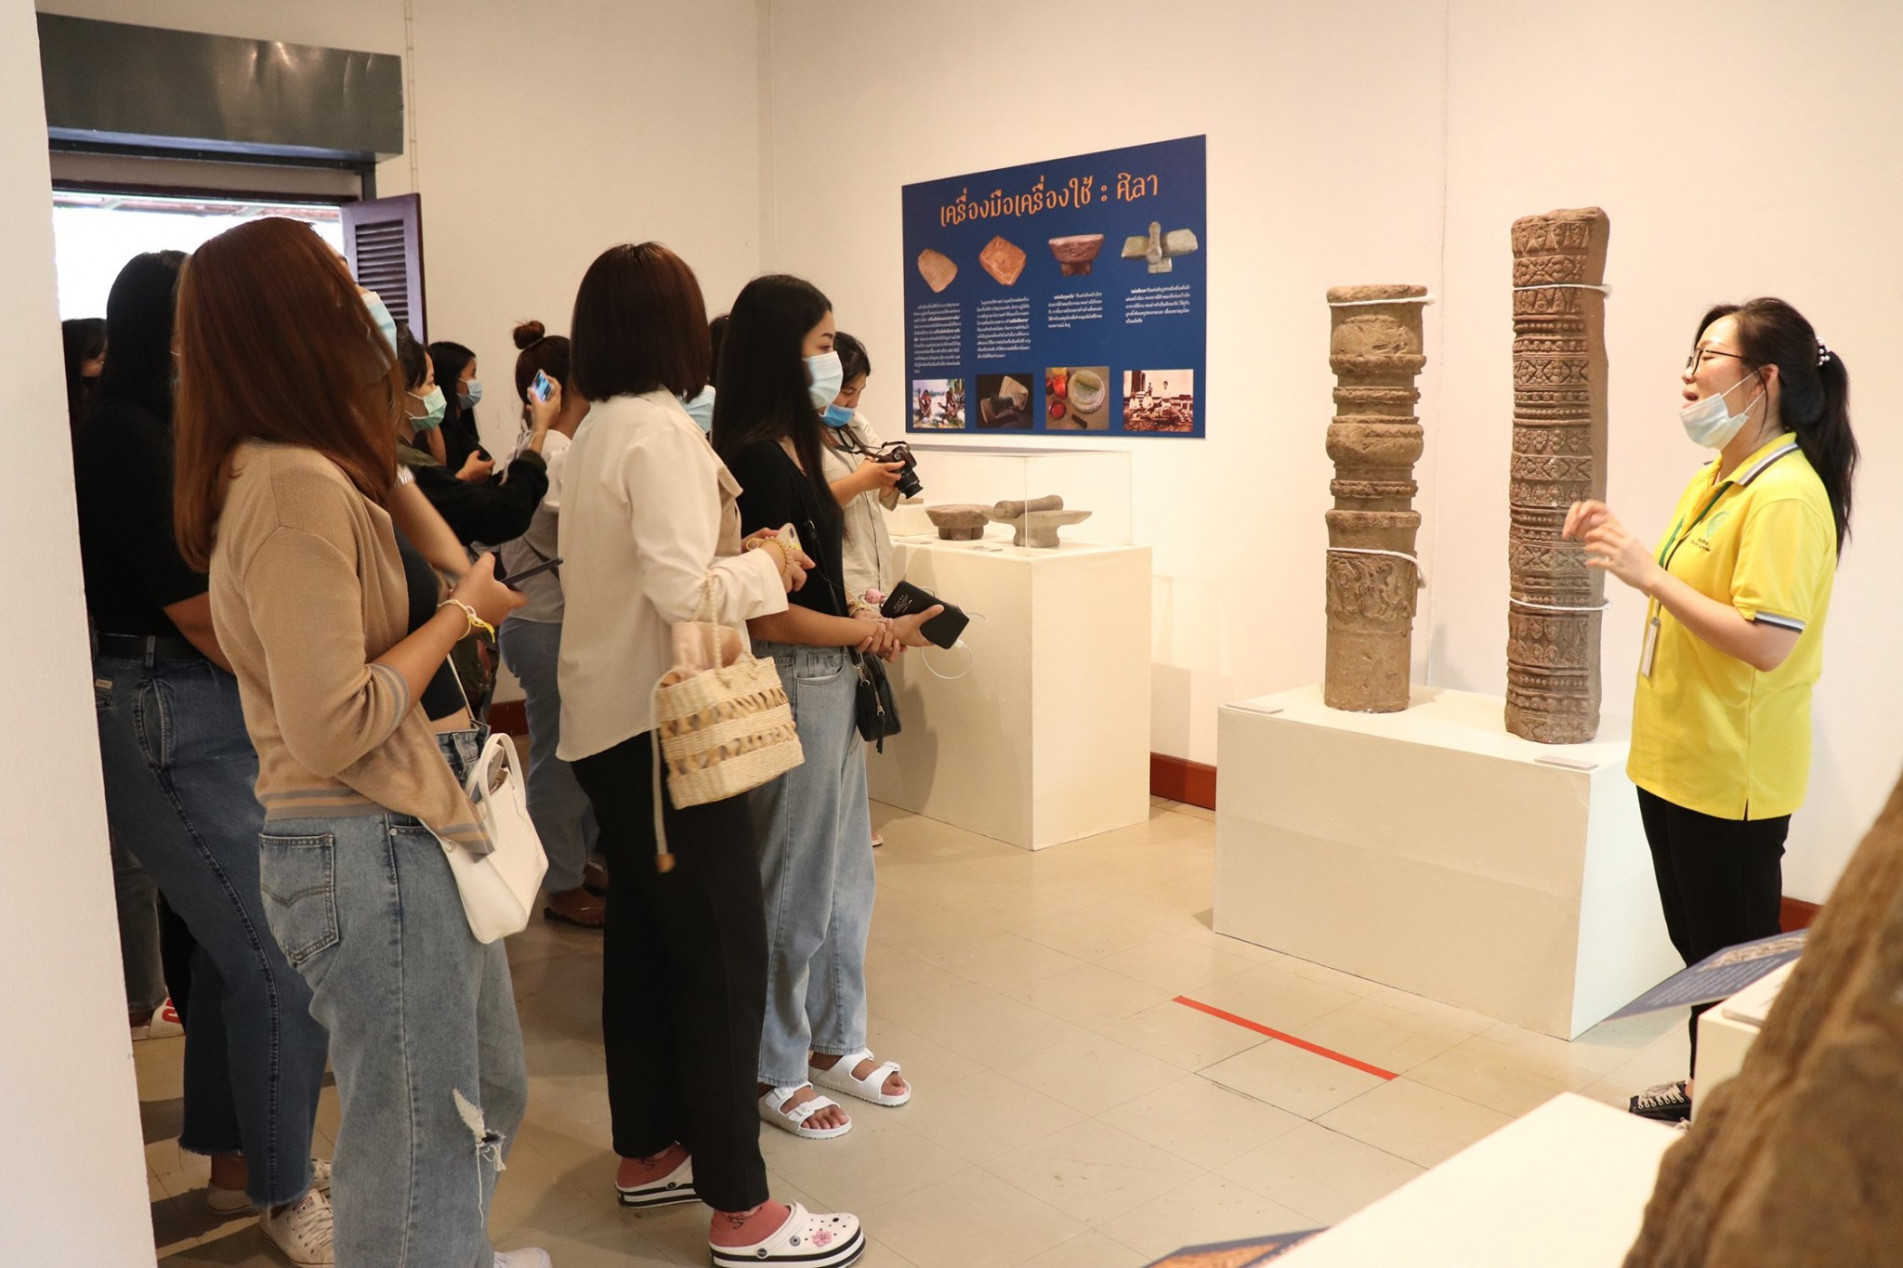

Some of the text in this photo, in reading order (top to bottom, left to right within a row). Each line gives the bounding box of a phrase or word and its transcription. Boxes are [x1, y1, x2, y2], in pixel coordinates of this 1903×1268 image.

[940, 175, 1094, 227] เครื่องมือเครื่องใช้
[1116, 172, 1159, 202] ศิลา
